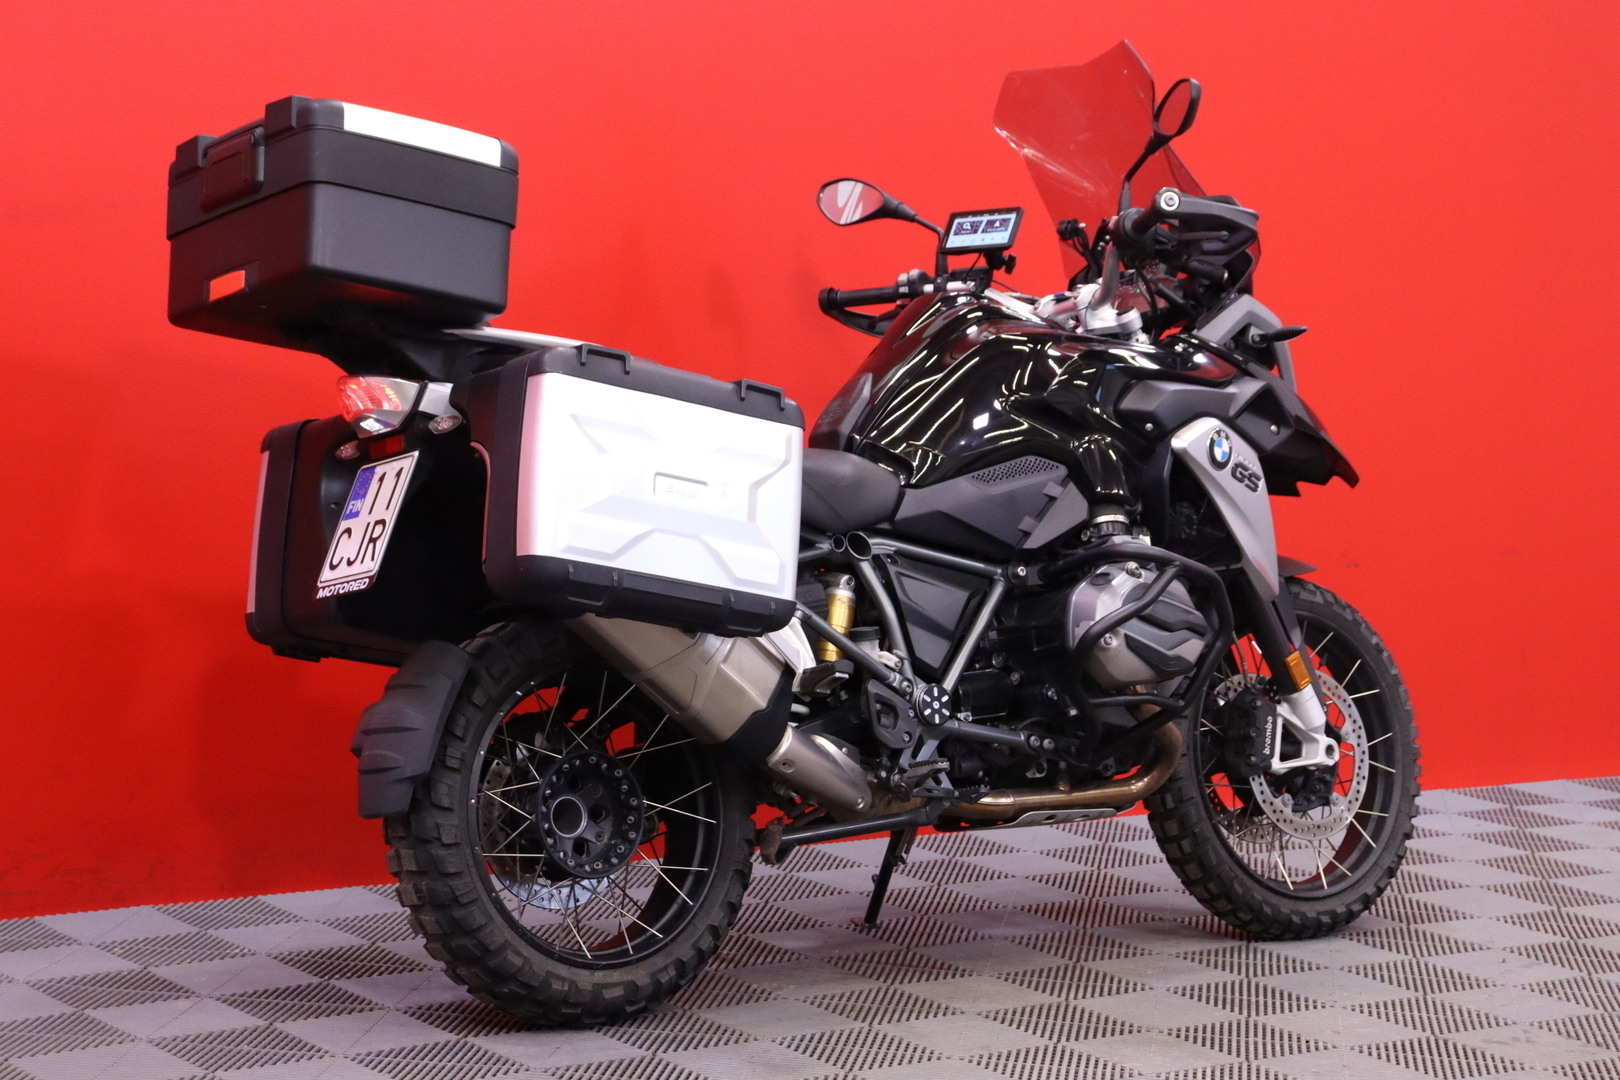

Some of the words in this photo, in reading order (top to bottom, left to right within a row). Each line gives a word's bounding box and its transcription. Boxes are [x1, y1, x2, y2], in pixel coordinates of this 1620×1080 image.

[1212, 431, 1233, 447] BMW
[368, 466, 405, 515] 11
[1231, 461, 1263, 493] GS
[346, 498, 365, 515] FIN
[329, 518, 387, 571] CJR
[316, 578, 370, 599] MOTORED
[1263, 715, 1274, 755] brembo
